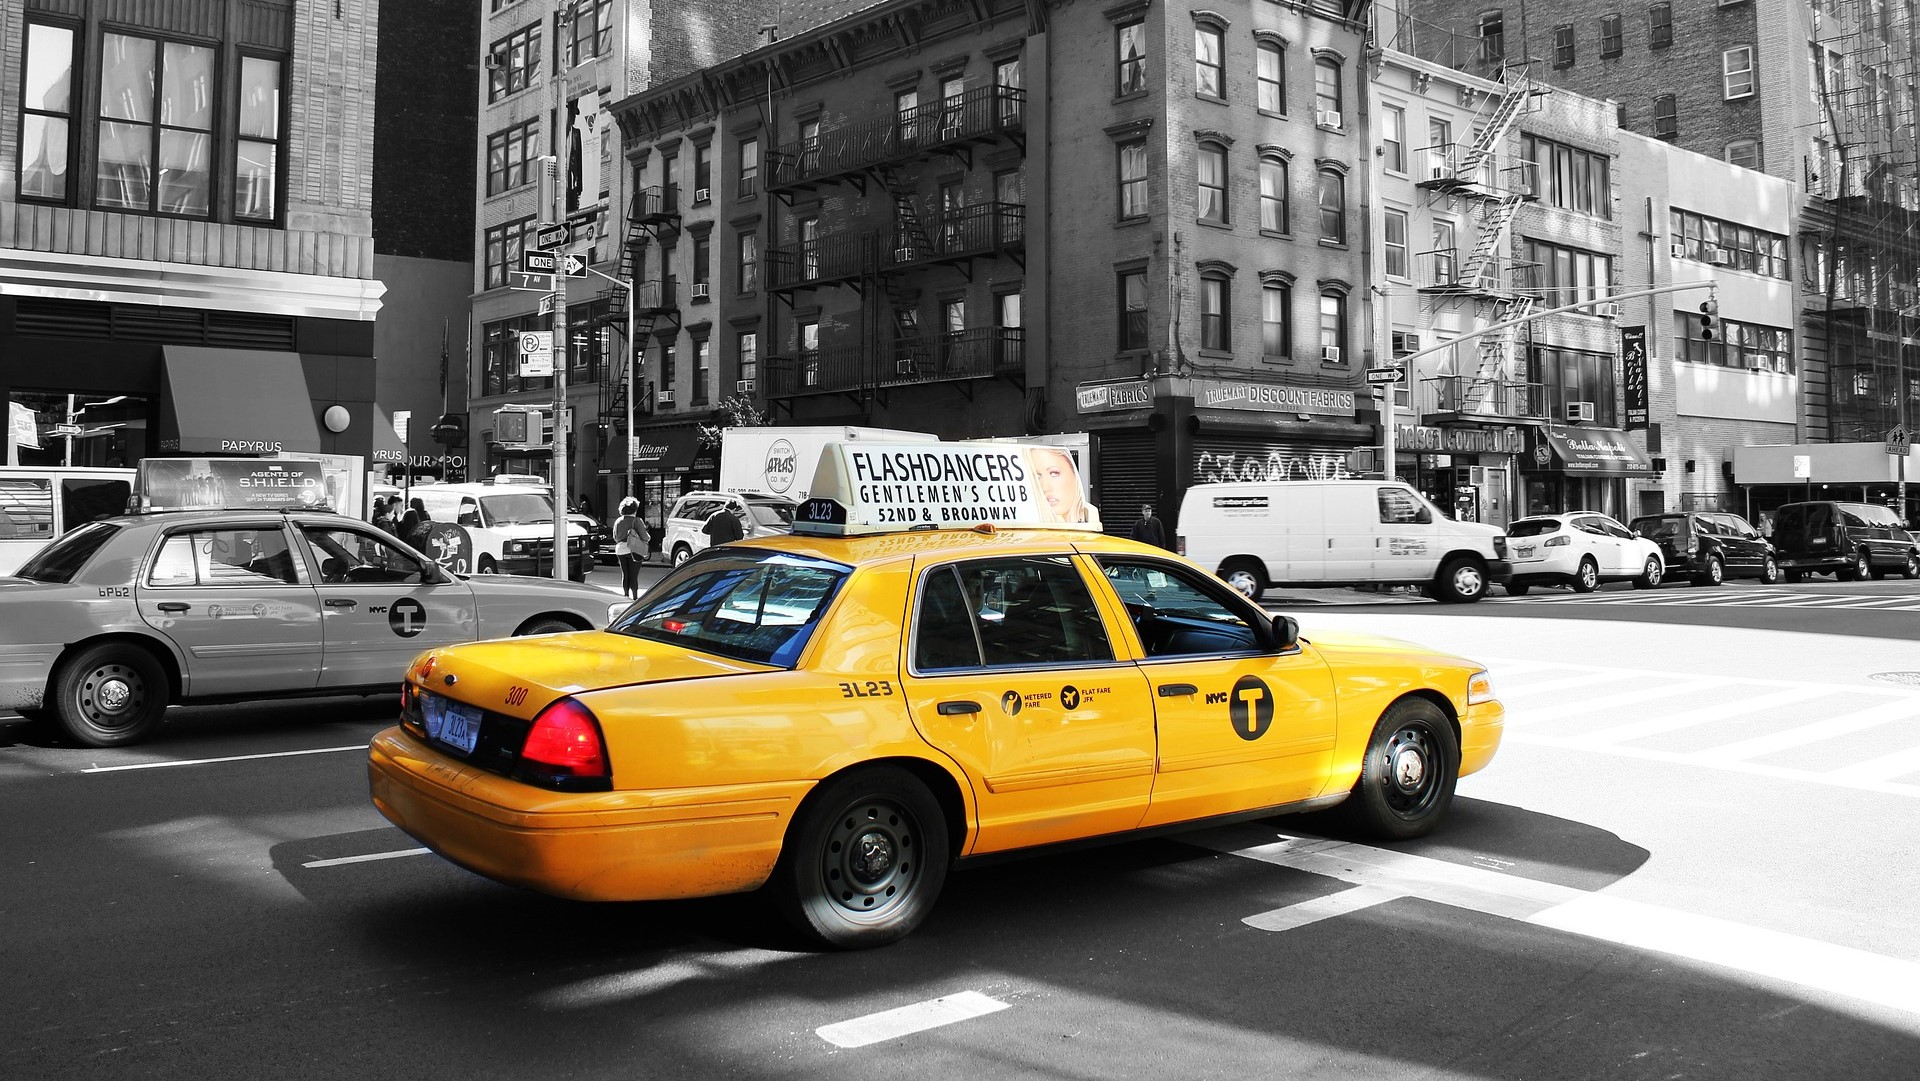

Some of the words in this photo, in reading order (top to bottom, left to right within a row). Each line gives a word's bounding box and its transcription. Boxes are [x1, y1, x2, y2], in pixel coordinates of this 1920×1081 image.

[542, 233, 551, 244] ONE
[555, 230, 565, 240] WAY
[534, 258, 552, 267] ONE
[522, 274, 529, 287] 7
[1109, 385, 1149, 407] FABRICS
[1206, 386, 1247, 404] TRUEMART
[1249, 386, 1308, 405] DISCOUNT
[1309, 391, 1351, 409] FABRICS
[221, 440, 282, 451] PAPYRUS
[639, 445, 669, 454] ilanes
[1567, 439, 1595, 450] Bella
[1596, 440, 1625, 456] Napoli
[373, 450, 402, 460] YRUS
[768, 455, 794, 473] ATLAS
[853, 452, 1024, 481] FLASHDANCERS
[240, 478, 320, 487] S.H.I.E.L.D.
[860, 484, 979, 503] GENTLEMEN'S
[988, 485, 1028, 502] CLUB
[1214, 498, 1268, 506] enterprise
[808, 502, 832, 520] 3L23
[879, 508, 916, 522] 52ND
[922, 508, 932, 521] &
[942, 507, 1017, 521] BROADWAY
[397, 605, 417, 632] T
[504, 686, 529, 706] 300
[839, 681, 893, 697] 3L23
[1024, 693, 1052, 701] METERED
[1206, 692, 1227, 704] NYC
[1238, 687, 1263, 732] T
